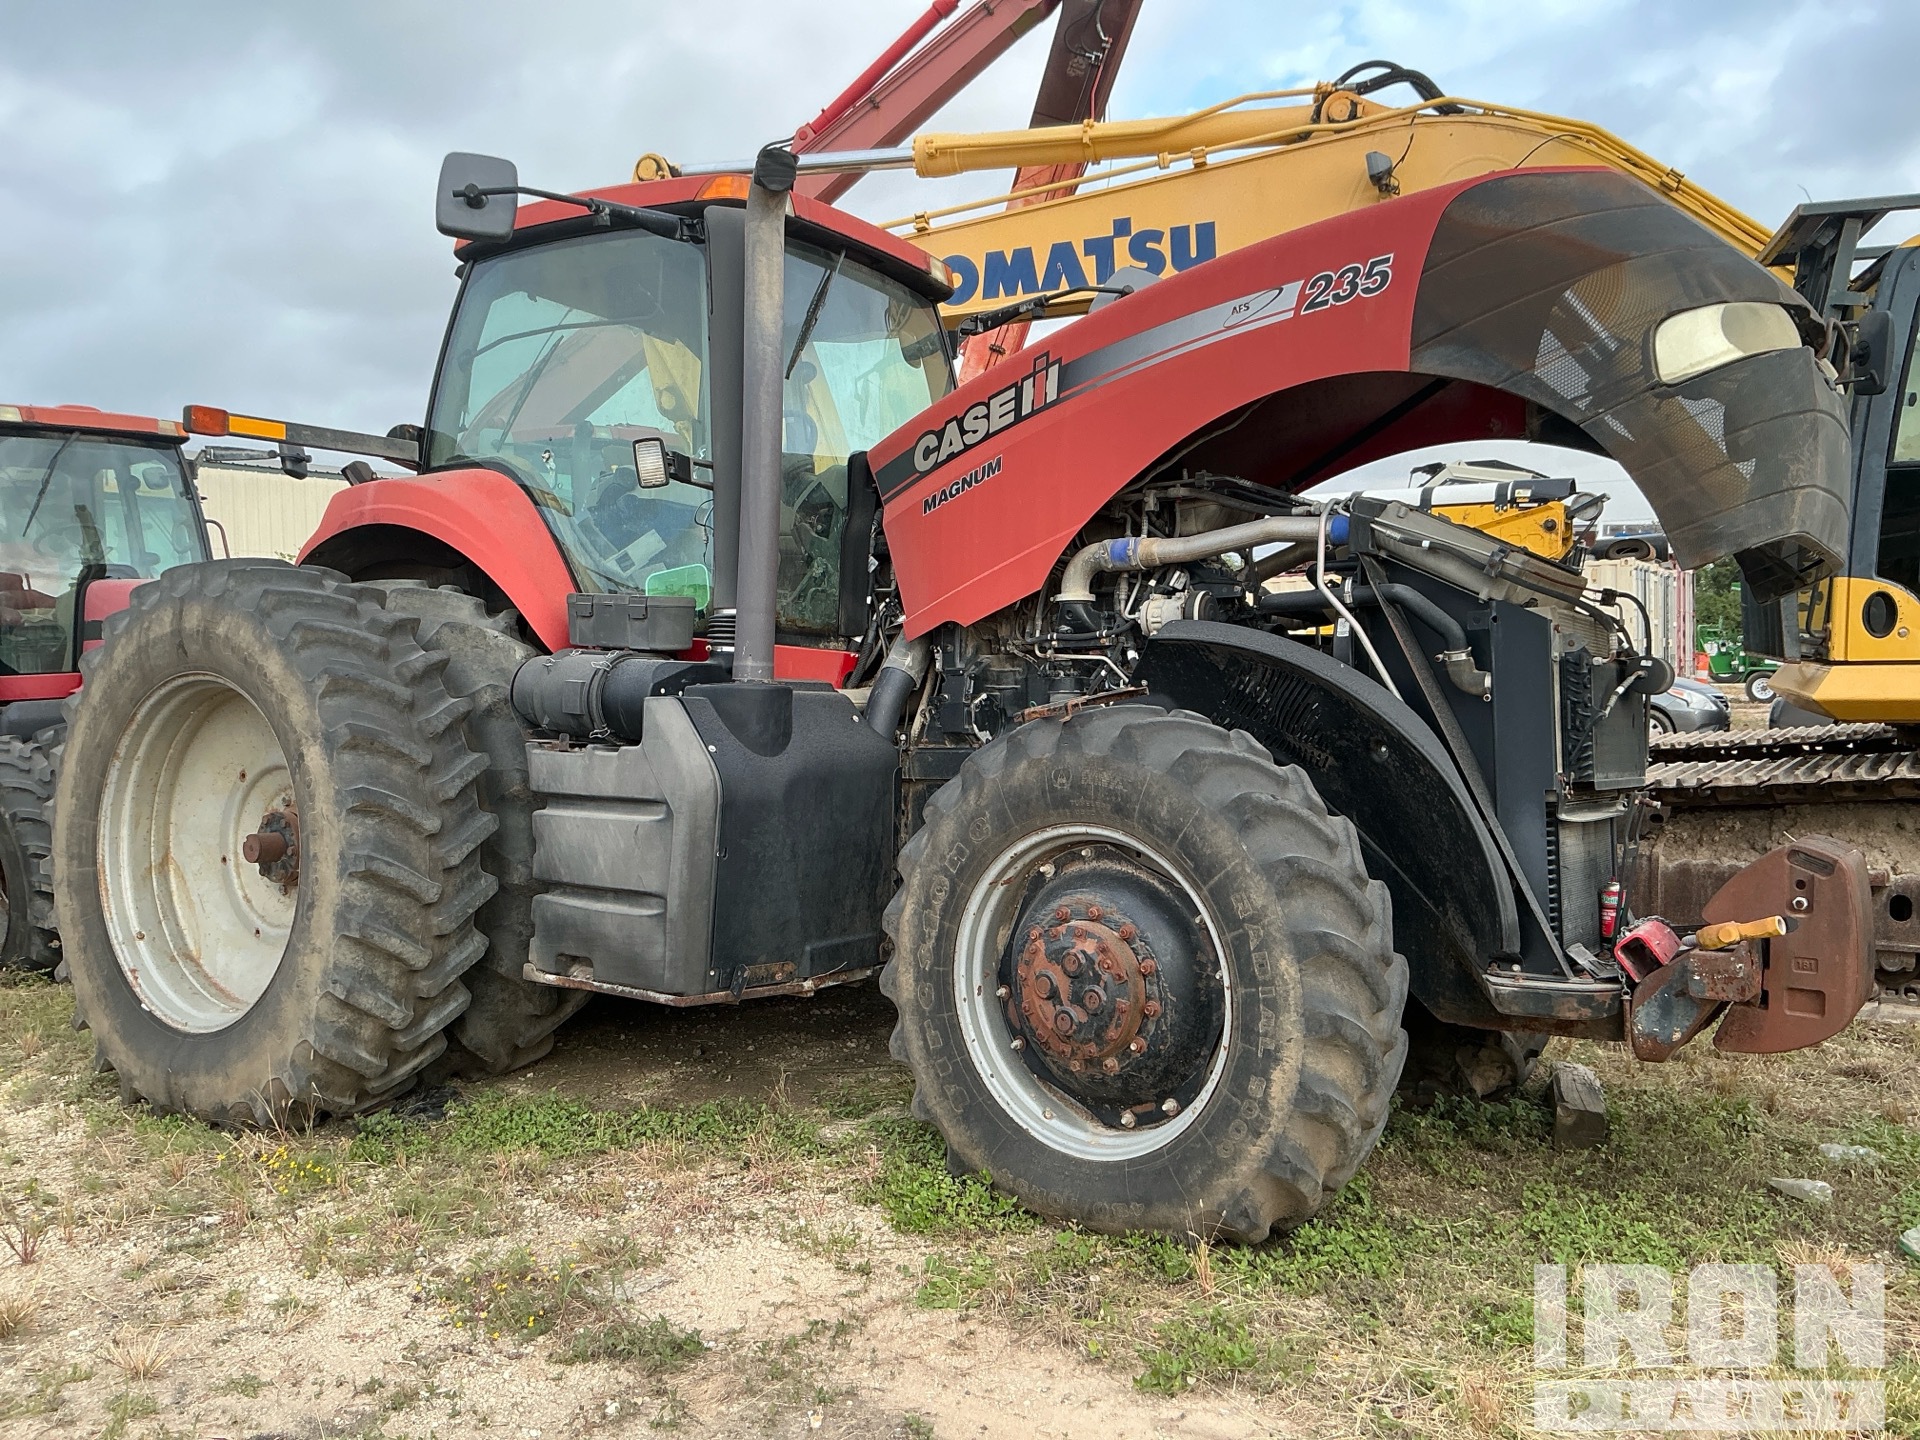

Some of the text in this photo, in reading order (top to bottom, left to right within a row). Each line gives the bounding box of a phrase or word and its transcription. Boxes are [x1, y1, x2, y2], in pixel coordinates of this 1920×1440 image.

[941, 217, 1216, 306] OMATSU
[1300, 253, 1395, 316] 235
[1231, 301, 1250, 316] AFS
[913, 386, 1007, 473] CASE
[923, 454, 1003, 516] MAGNUM
